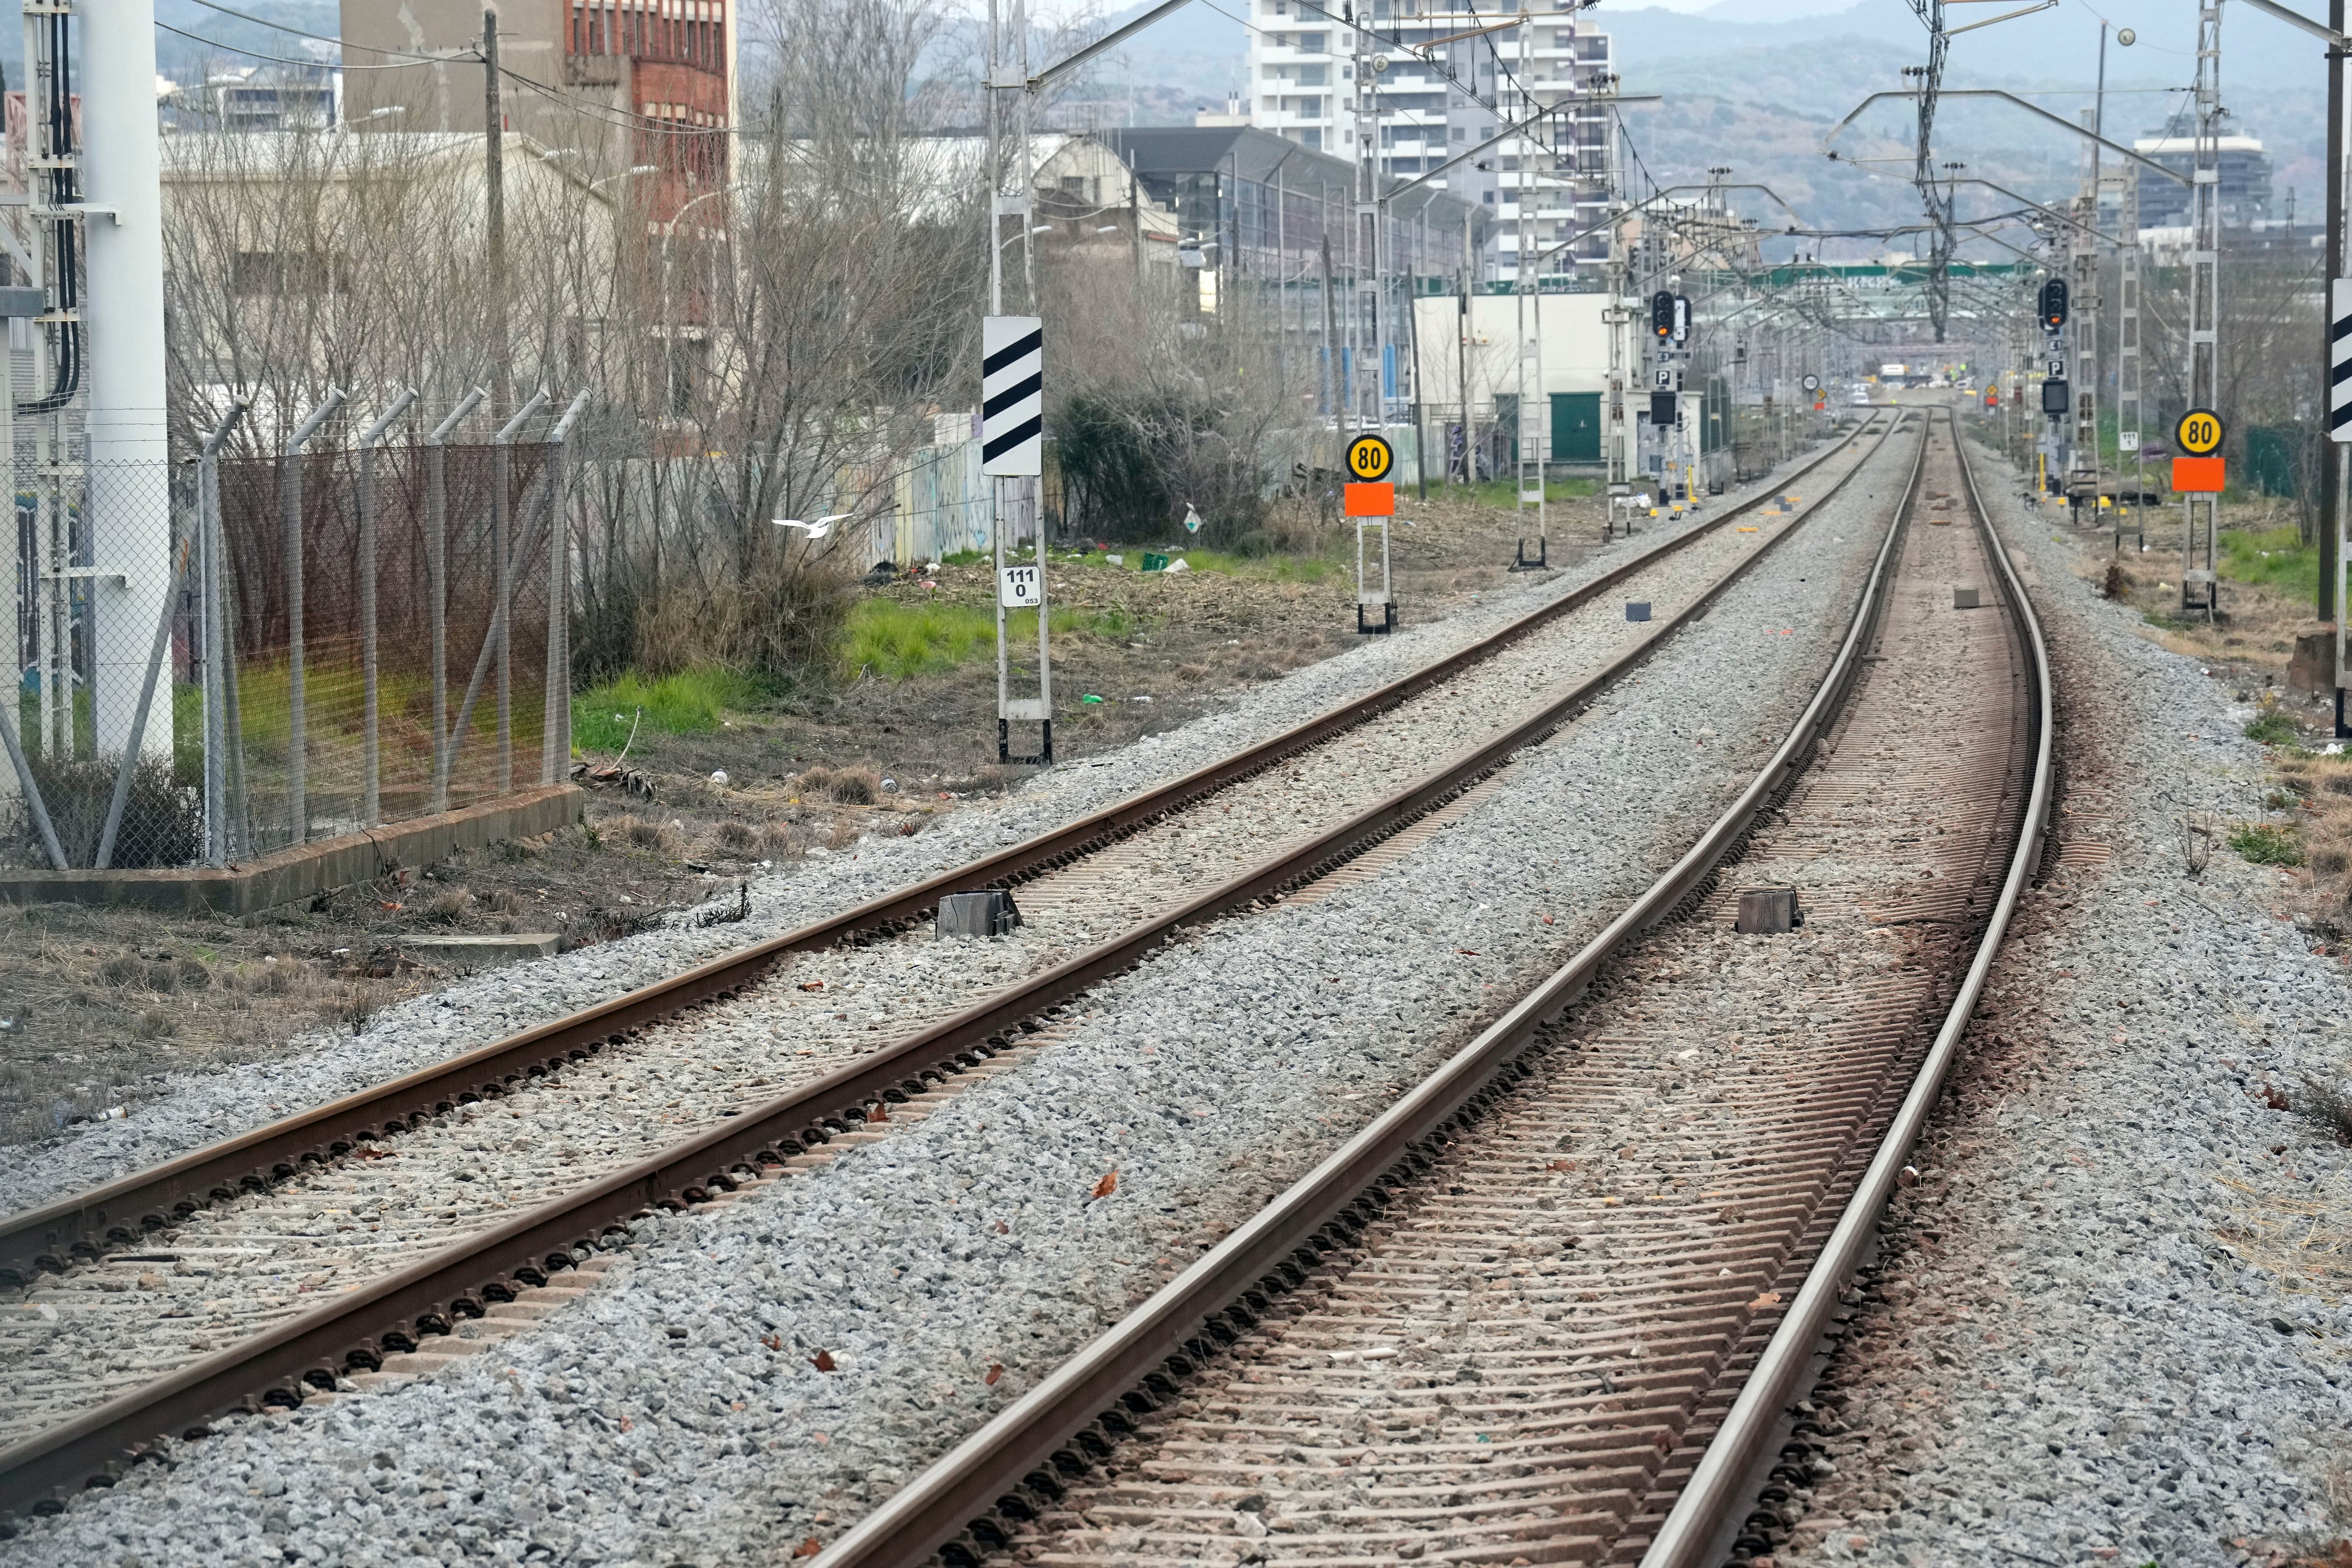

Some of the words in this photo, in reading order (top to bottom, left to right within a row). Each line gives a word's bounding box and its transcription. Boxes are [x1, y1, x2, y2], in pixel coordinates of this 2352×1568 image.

[2052, 362, 2060, 375] P
[1659, 371, 1668, 384] P
[2189, 421, 2212, 444] 80
[1359, 447, 1381, 470] 80
[1007, 569, 1033, 583] 111
[1016, 584, 1026, 597] 0
